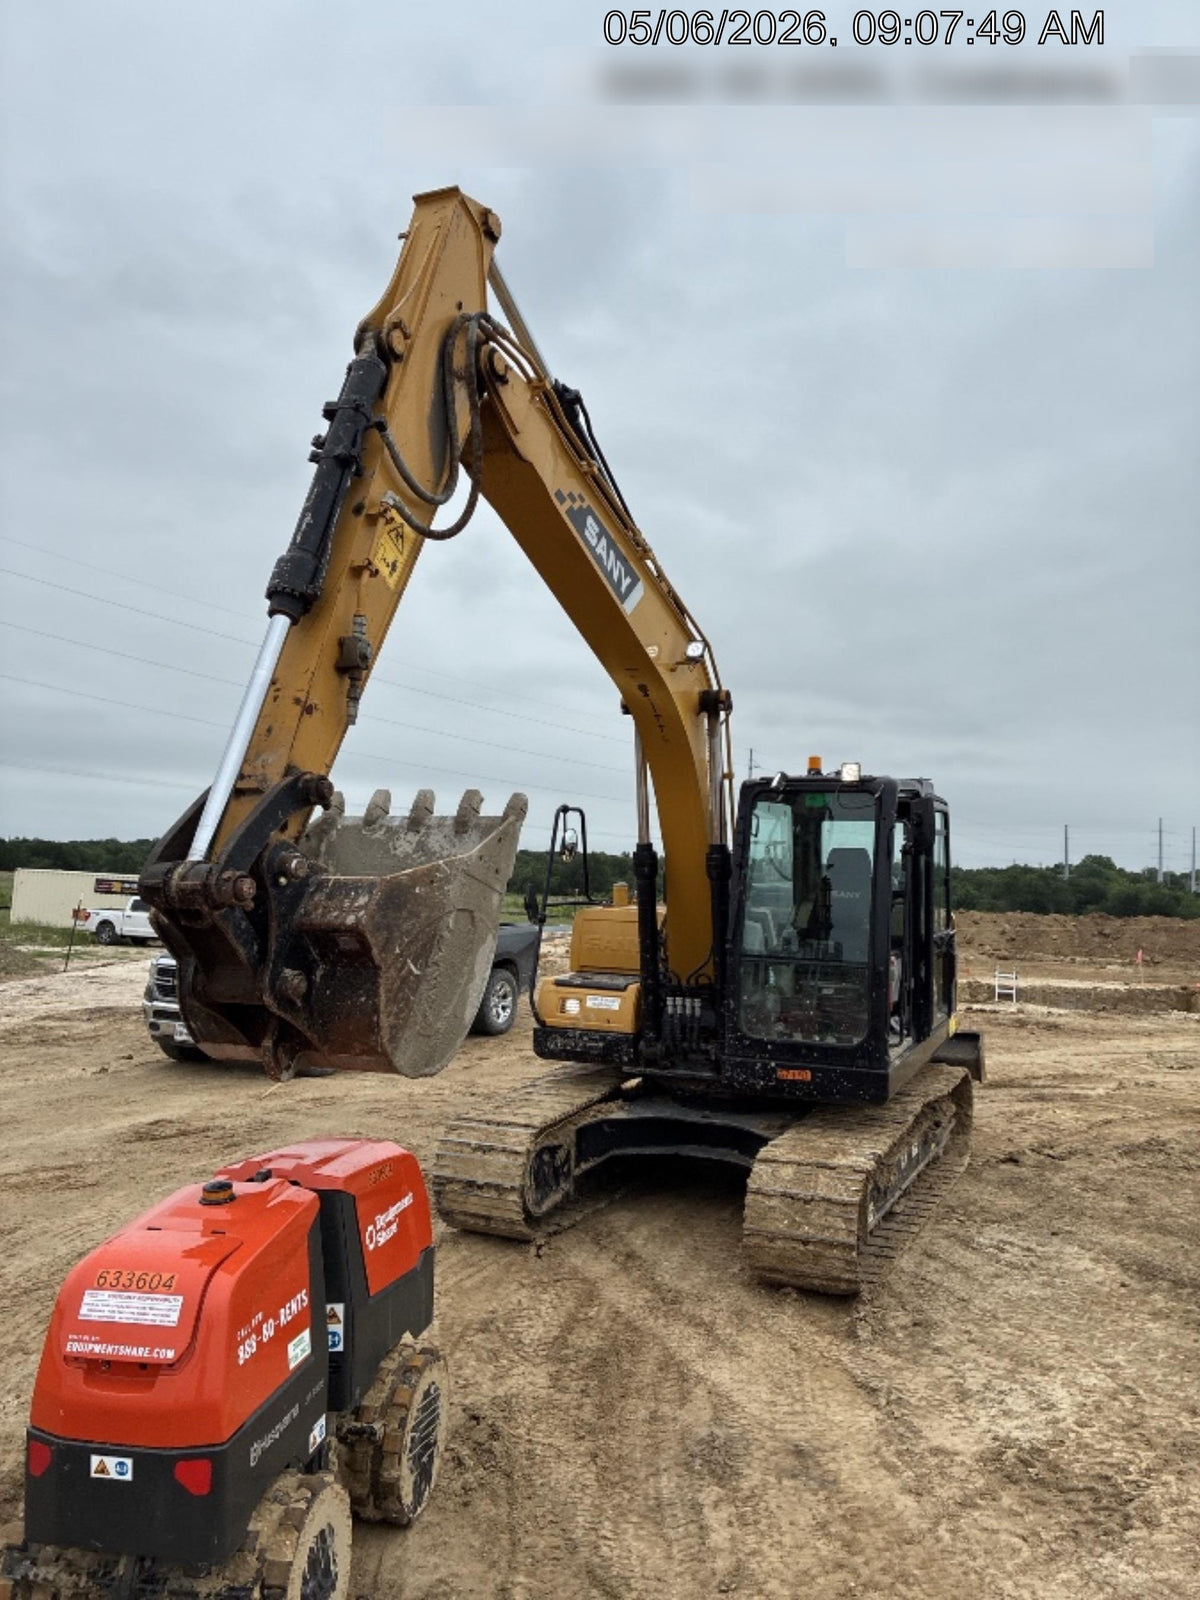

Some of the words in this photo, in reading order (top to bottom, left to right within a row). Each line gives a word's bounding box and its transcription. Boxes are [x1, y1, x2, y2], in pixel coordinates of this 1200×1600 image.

[584, 515, 632, 594] SANY
[96, 1270, 176, 1291] 633604
[66, 1341, 175, 1359] EQUIPMENTSHARE.COM
